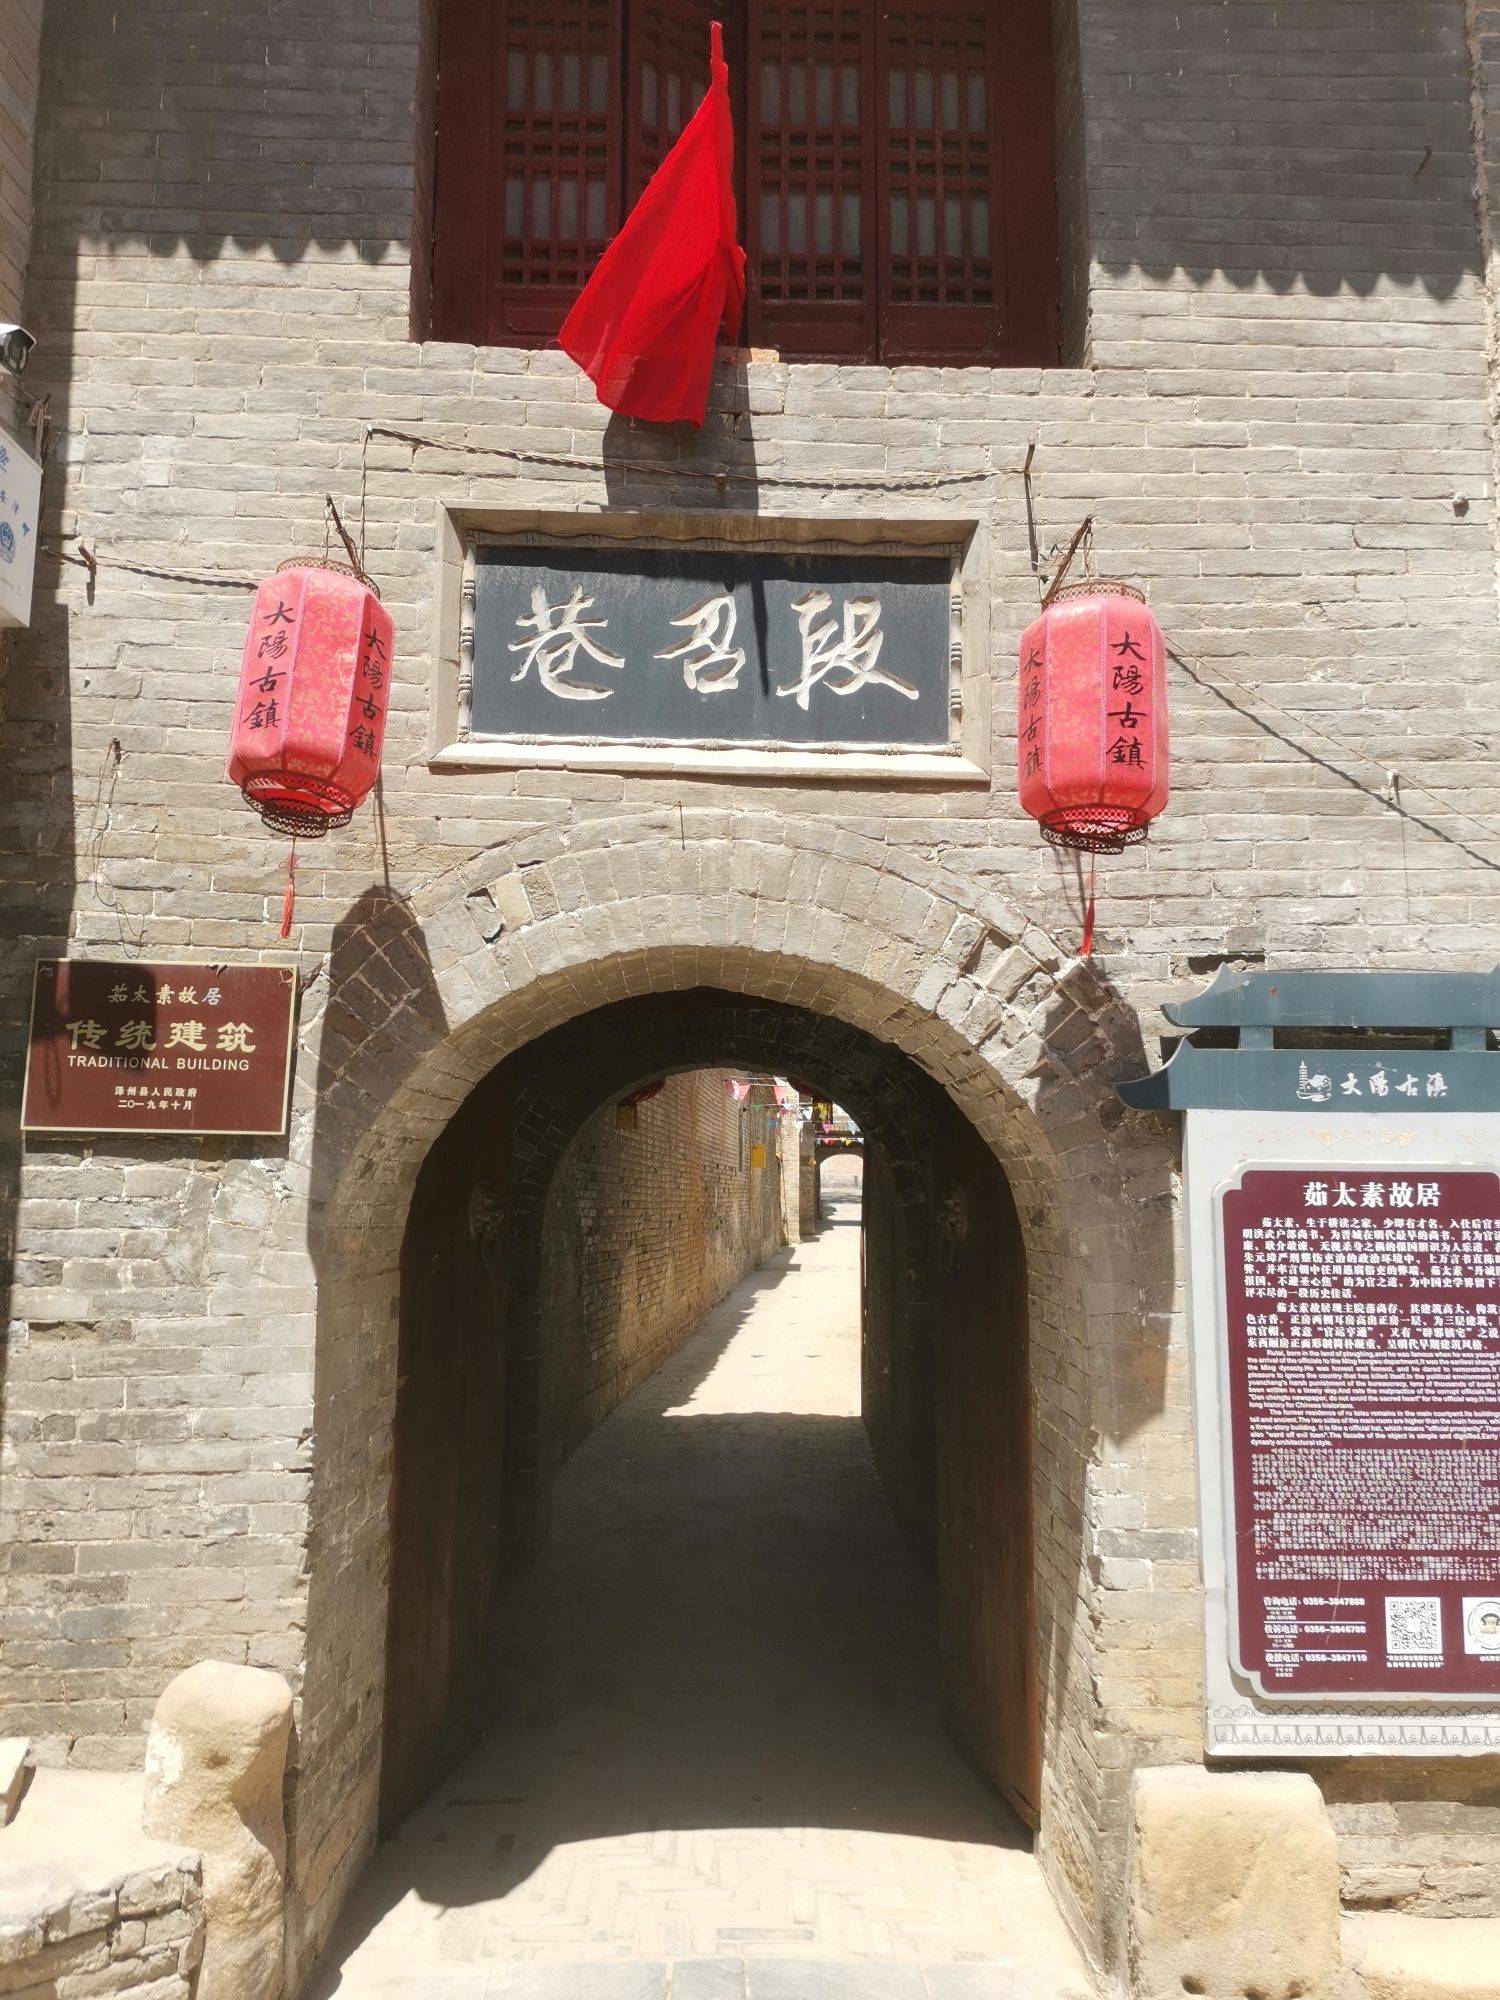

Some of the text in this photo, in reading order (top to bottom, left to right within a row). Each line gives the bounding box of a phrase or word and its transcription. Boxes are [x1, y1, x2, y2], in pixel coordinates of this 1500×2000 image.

[108, 983, 222, 1006] 茹太素故居
[65, 1019, 256, 1053] 传统建筑
[68, 1055, 250, 1071] TRADITIONAL BUILDING
[114, 1086, 198, 1098] 泽州县人民政府
[1303, 1181, 1442, 1208] 茹太素故居
